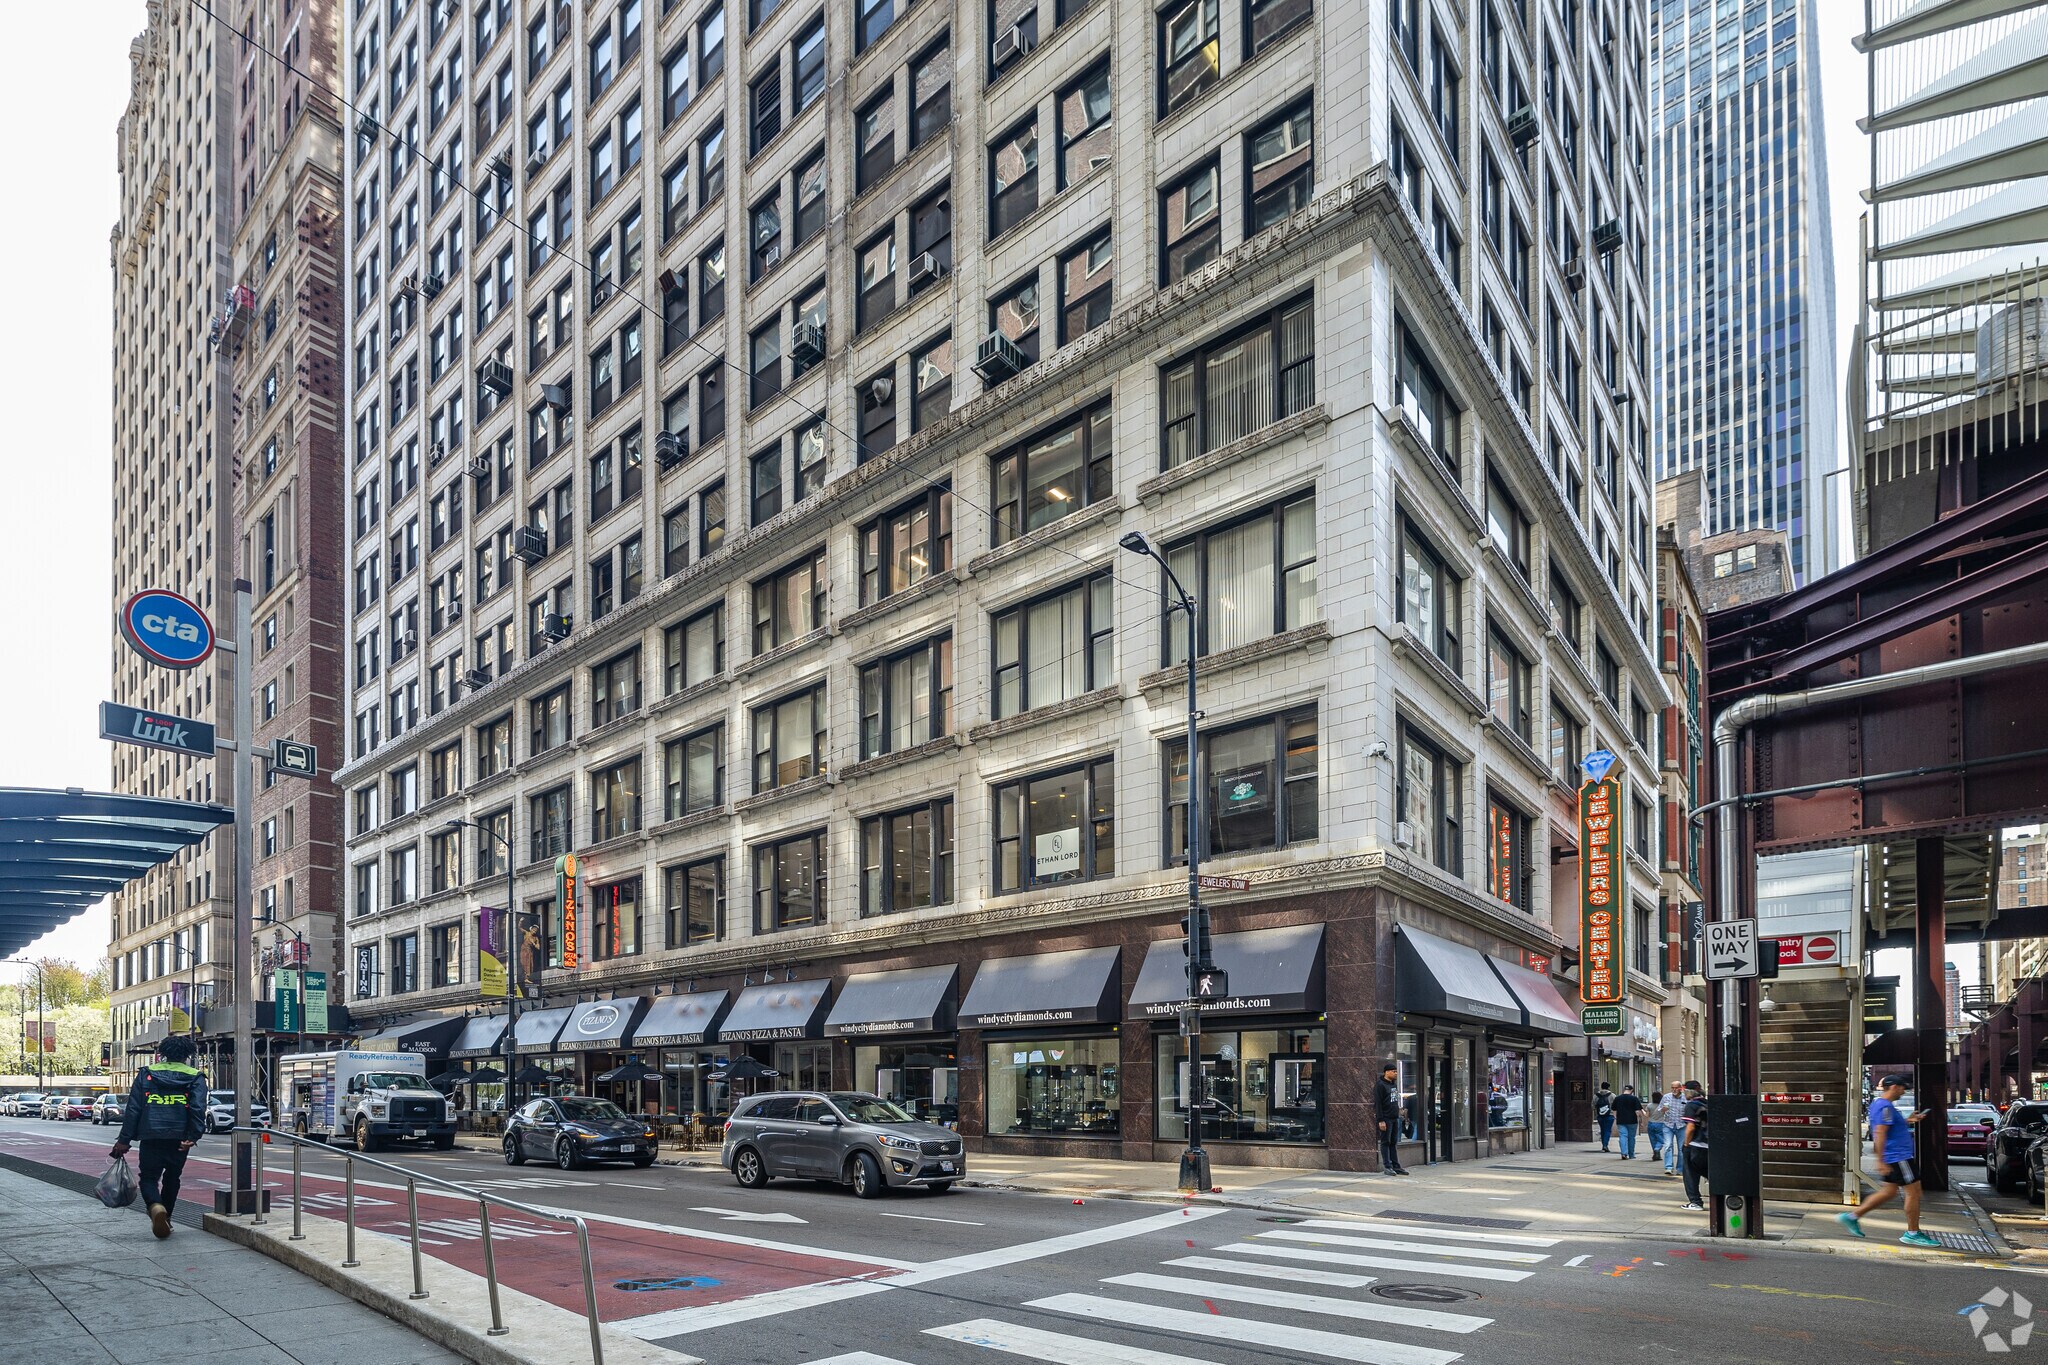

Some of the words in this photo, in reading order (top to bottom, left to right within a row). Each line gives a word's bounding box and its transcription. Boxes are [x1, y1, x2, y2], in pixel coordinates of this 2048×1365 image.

[142, 614, 199, 643] cta
[155, 719, 173, 727] LOOP
[1585, 785, 1613, 906] JEWELERS
[1037, 855, 1059, 865] ETHAN
[1060, 851, 1079, 861] LORD
[1200, 876, 1231, 889] JEWELERS
[1231, 879, 1246, 890] ROW
[1711, 924, 1749, 940] ONE
[1589, 911, 1612, 999] CENTER
[1711, 940, 1749, 956] WAY
[360, 951, 368, 992] CANTINA
[582, 1015, 614, 1026] PIZANO'S
[977, 1010, 1073, 1026] windycitydiamonds.com
[1584, 1010, 1619, 1018] MALLERS
[721, 1030, 751, 1041] PIZANO'S
[752, 1029, 772, 1039] PIZZA
[772, 1028, 779, 1038] &
[779, 1027, 802, 1037] PASTA
[840, 1021, 914, 1034] windycitydiamonds.com
[561, 1042, 583, 1050] PIZANO'S
[583, 1041, 596, 1049] PIZZA
[601, 1039, 617, 1047] PASTA
[635, 1036, 660, 1046] PIZANO'S
[660, 1035, 676, 1045] PIZZA
[676, 1035, 682, 1043] &
[682, 1033, 701, 1043] PASTA
[349, 1052, 415, 1061] ReadyRefresh.com
[147, 1094, 187, 1105] AIR
